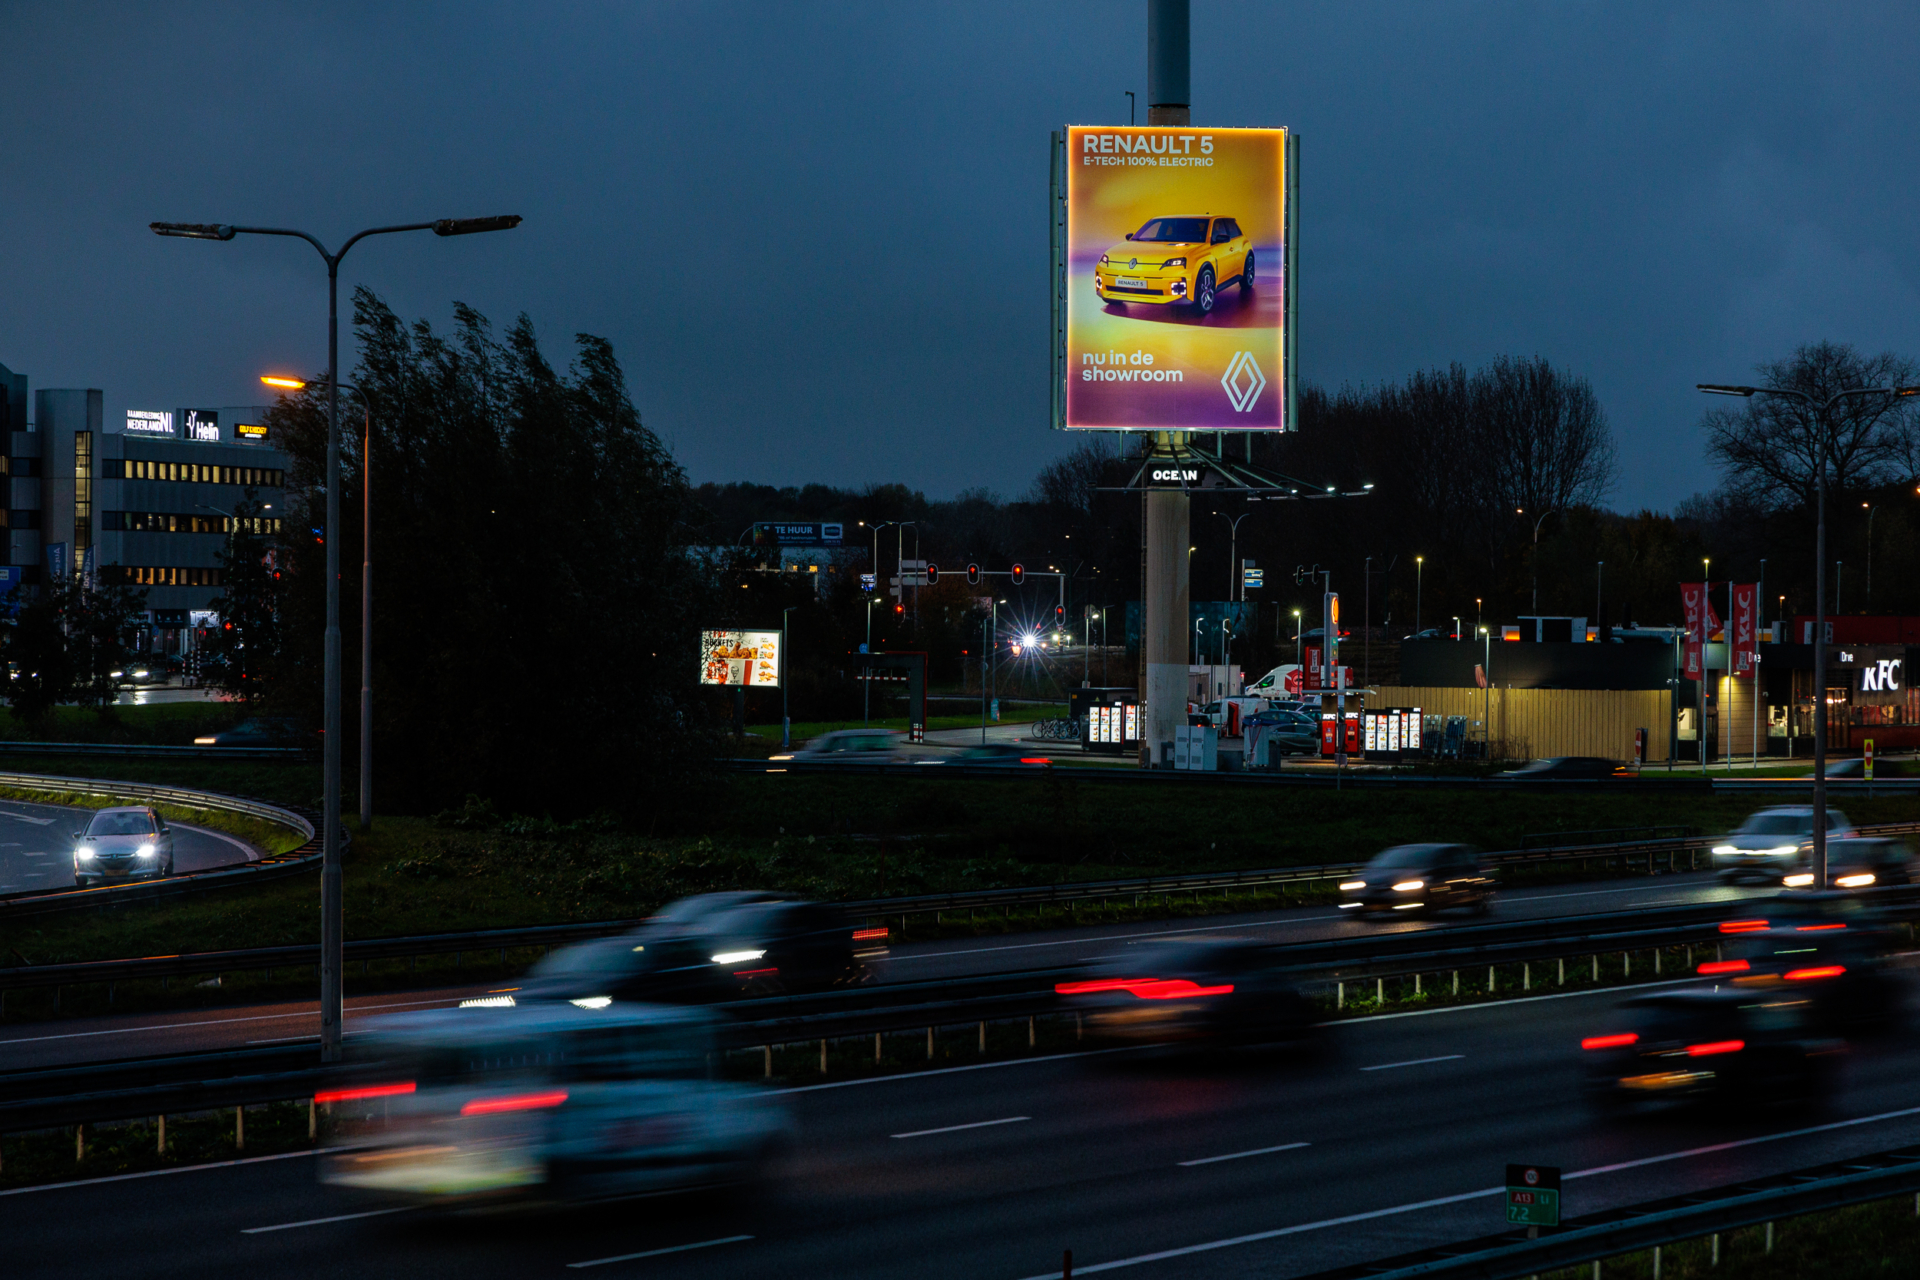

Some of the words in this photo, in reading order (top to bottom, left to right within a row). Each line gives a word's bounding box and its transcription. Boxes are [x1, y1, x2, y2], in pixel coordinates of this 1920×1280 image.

[1084, 134, 1196, 154] RENAULT
[1200, 135, 1214, 155] 5
[1084, 156, 1125, 166] E-TECH
[1127, 156, 1157, 166] 100%
[1159, 157, 1214, 167] ELECTRIC
[1083, 353, 1106, 365] nu
[1110, 349, 1127, 365] in
[1130, 349, 1154, 365] de
[1082, 366, 1183, 382] showroom
[127, 419, 161, 431] NEDERLAND
[160, 411, 174, 433] NL
[196, 421, 219, 440] Helin
[1152, 469, 1197, 481] OCEAN
[774, 526, 786, 534] TE
[787, 526, 813, 534] HUUR
[1862, 659, 1901, 691] KFC
[1514, 1192, 1531, 1203] A13
[1510, 1206, 1529, 1221] 7,2
